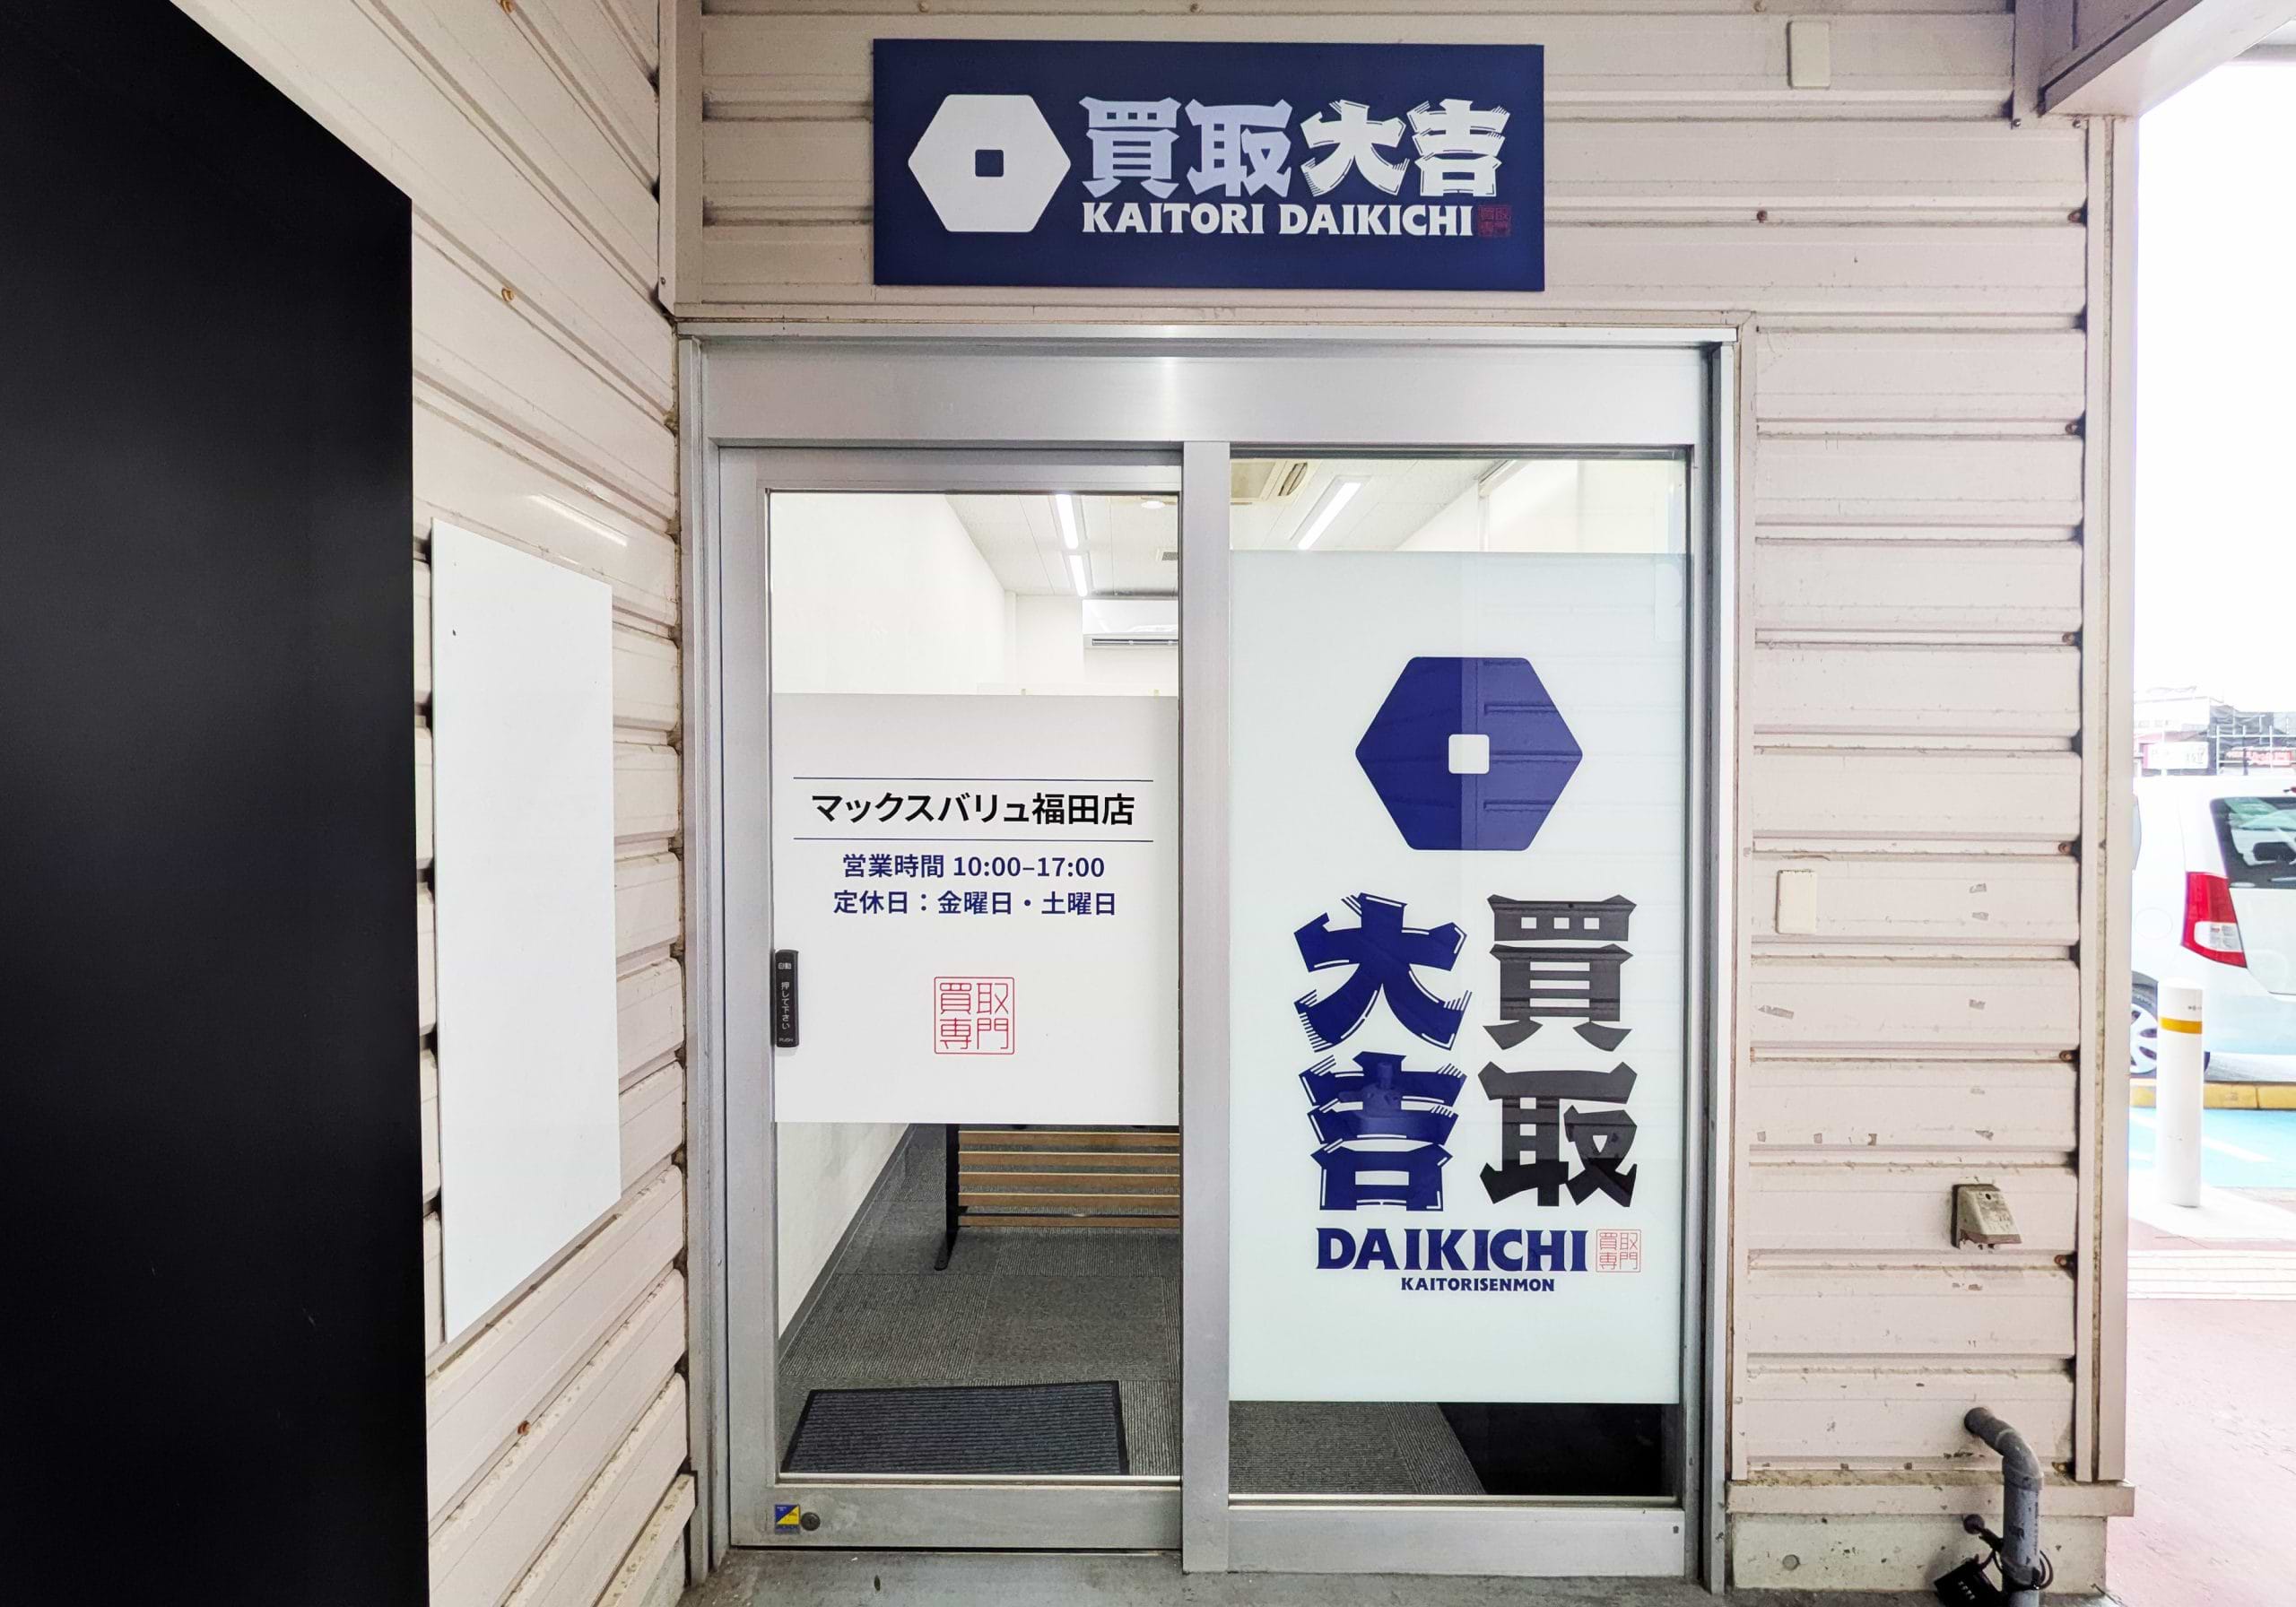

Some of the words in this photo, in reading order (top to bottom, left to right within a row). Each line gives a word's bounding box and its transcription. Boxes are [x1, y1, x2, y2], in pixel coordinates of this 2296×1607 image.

[1080, 96, 1510, 198] 買取大吉
[1082, 202, 1265, 234] KAITORI
[1278, 204, 1474, 237] DAIKICHI
[812, 792, 1135, 826] マックスバリュ福田店
[842, 853, 944, 879] 営業時間
[939, 982, 1010, 1015] 買取
[1294, 892, 1473, 1212] 大吉
[1477, 894, 1638, 1208] 買取
[1316, 1227, 1588, 1273] DAIKICHI
[1401, 1277, 1555, 1292] KAITORISENMON
